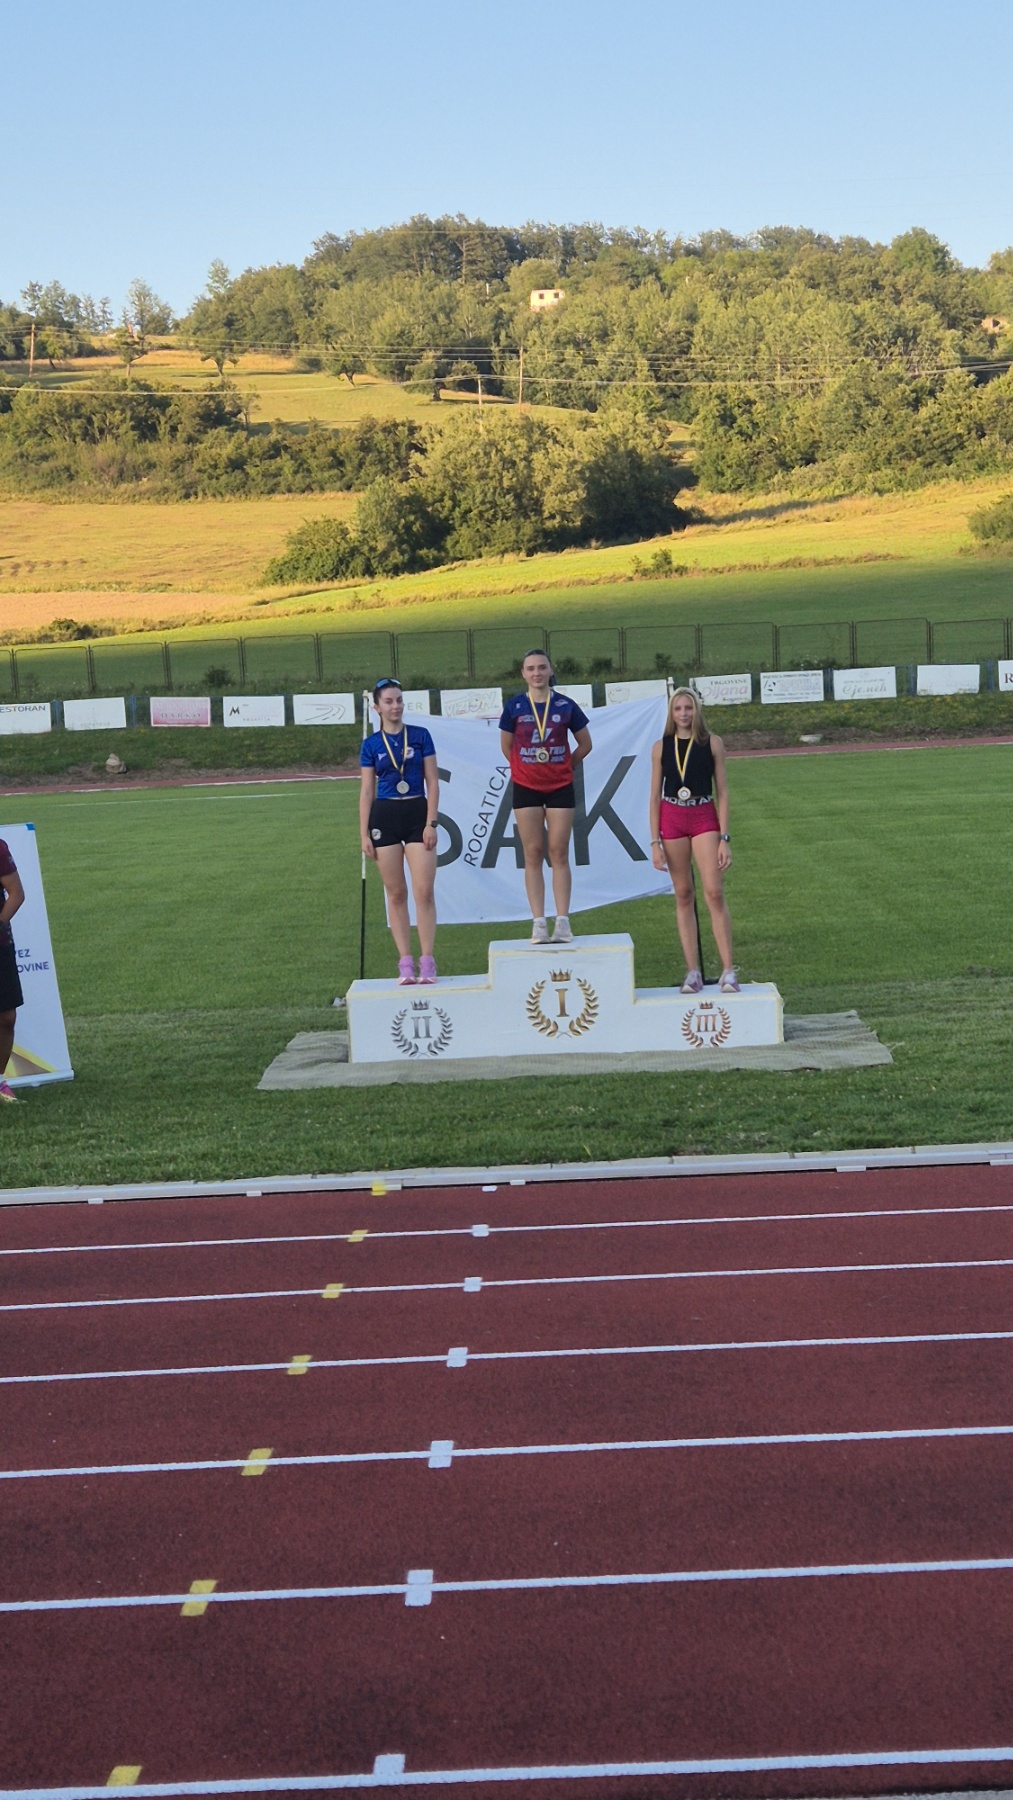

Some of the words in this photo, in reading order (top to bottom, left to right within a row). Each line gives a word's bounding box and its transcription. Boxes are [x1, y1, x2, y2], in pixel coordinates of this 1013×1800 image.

[1004, 672, 1013, 684] R
[0, 705, 46, 713] ESTORAN
[407, 702, 423, 711] ER
[464, 764, 511, 867] ROGATICA
[17, 961, 49, 973] OVINE
[411, 1015, 431, 1039] II
[696, 1014, 718, 1032] III
